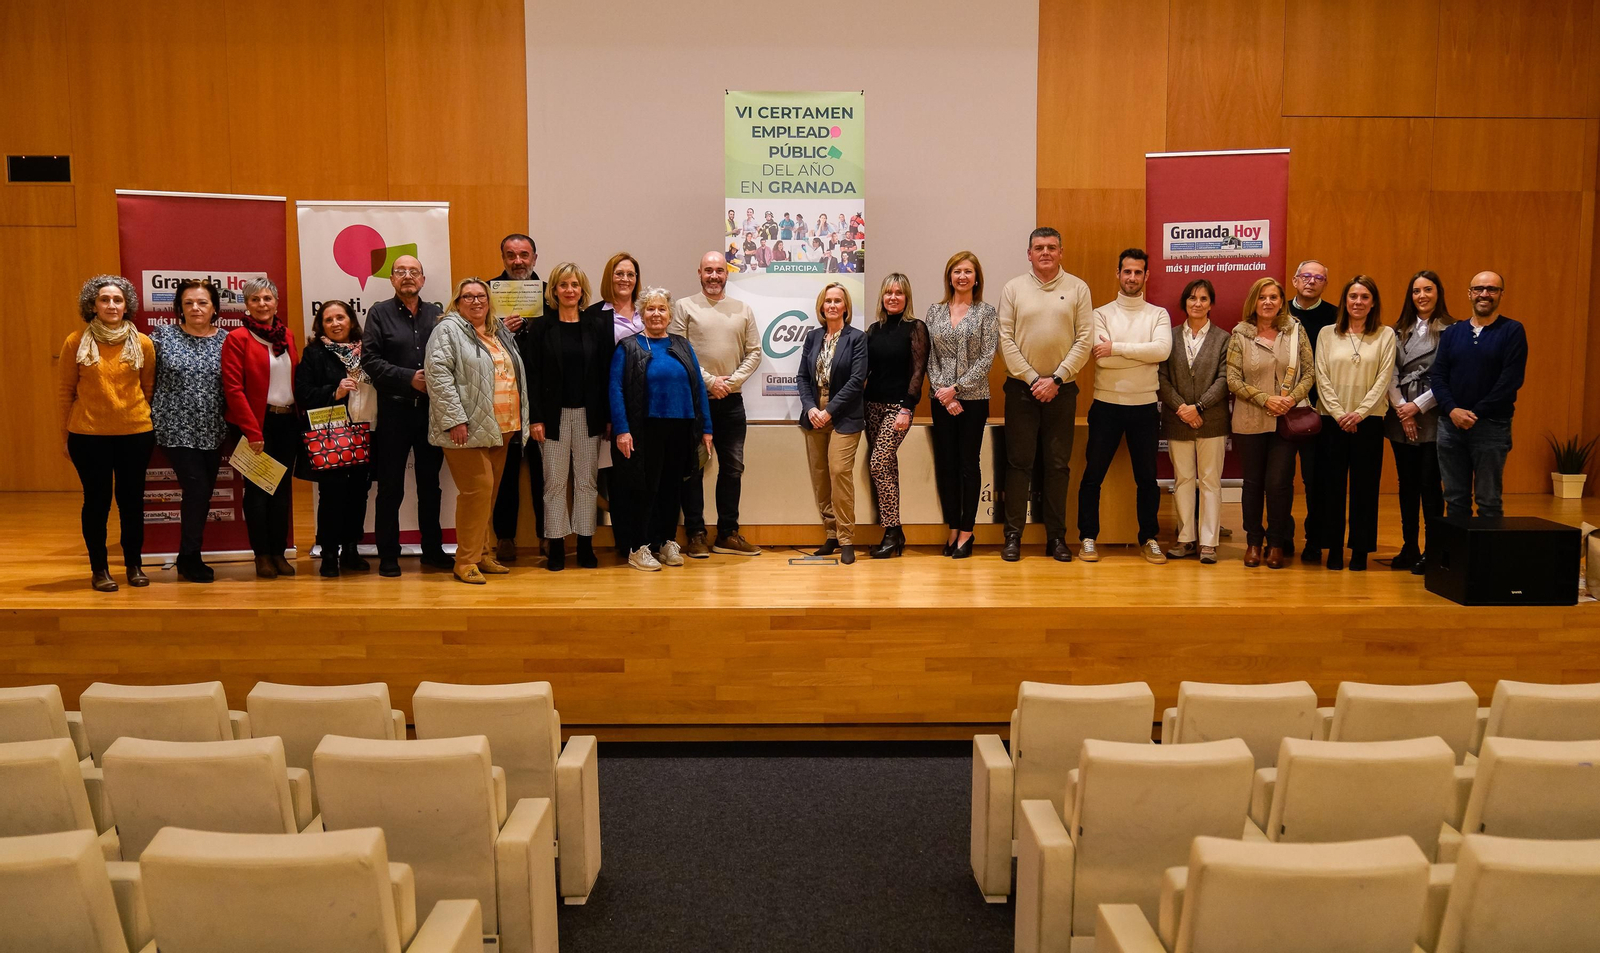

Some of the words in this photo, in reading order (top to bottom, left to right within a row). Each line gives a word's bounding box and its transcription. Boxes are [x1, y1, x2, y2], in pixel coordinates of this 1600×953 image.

[735, 106, 752, 119] VI
[757, 106, 854, 120] CERTAMEN
[762, 164, 794, 177] DEL
[797, 162, 835, 177] AÑO
[741, 181, 763, 194] EN
[768, 181, 857, 194] GRANADA
[1170, 225, 1230, 239] Granada
[1234, 224, 1262, 241] Hoy
[773, 264, 819, 272] PARTICIPA
[1165, 263, 1183, 273] más
[1184, 265, 1190, 274] y
[1191, 263, 1216, 274] mejor
[1216, 261, 1266, 273] información
[147, 315, 169, 326] más
